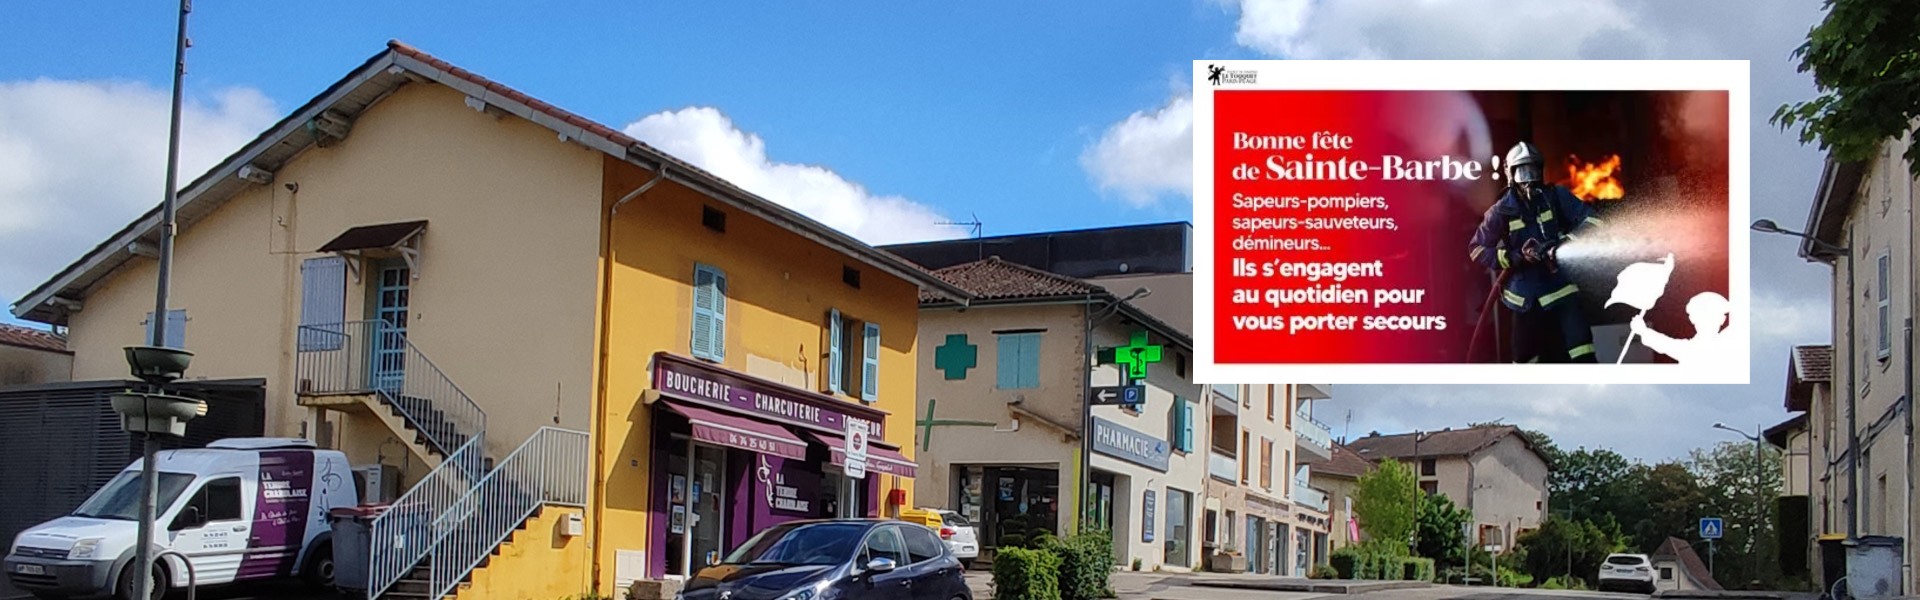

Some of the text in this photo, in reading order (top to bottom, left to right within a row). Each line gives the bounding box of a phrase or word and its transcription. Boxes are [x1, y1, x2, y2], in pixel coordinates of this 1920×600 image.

[667, 371, 731, 402] BOUCHERIE
[755, 393, 821, 423] CHARCUTERIE
[1096, 424, 1149, 457] PHARMACIE
[775, 472, 785, 485] LA
